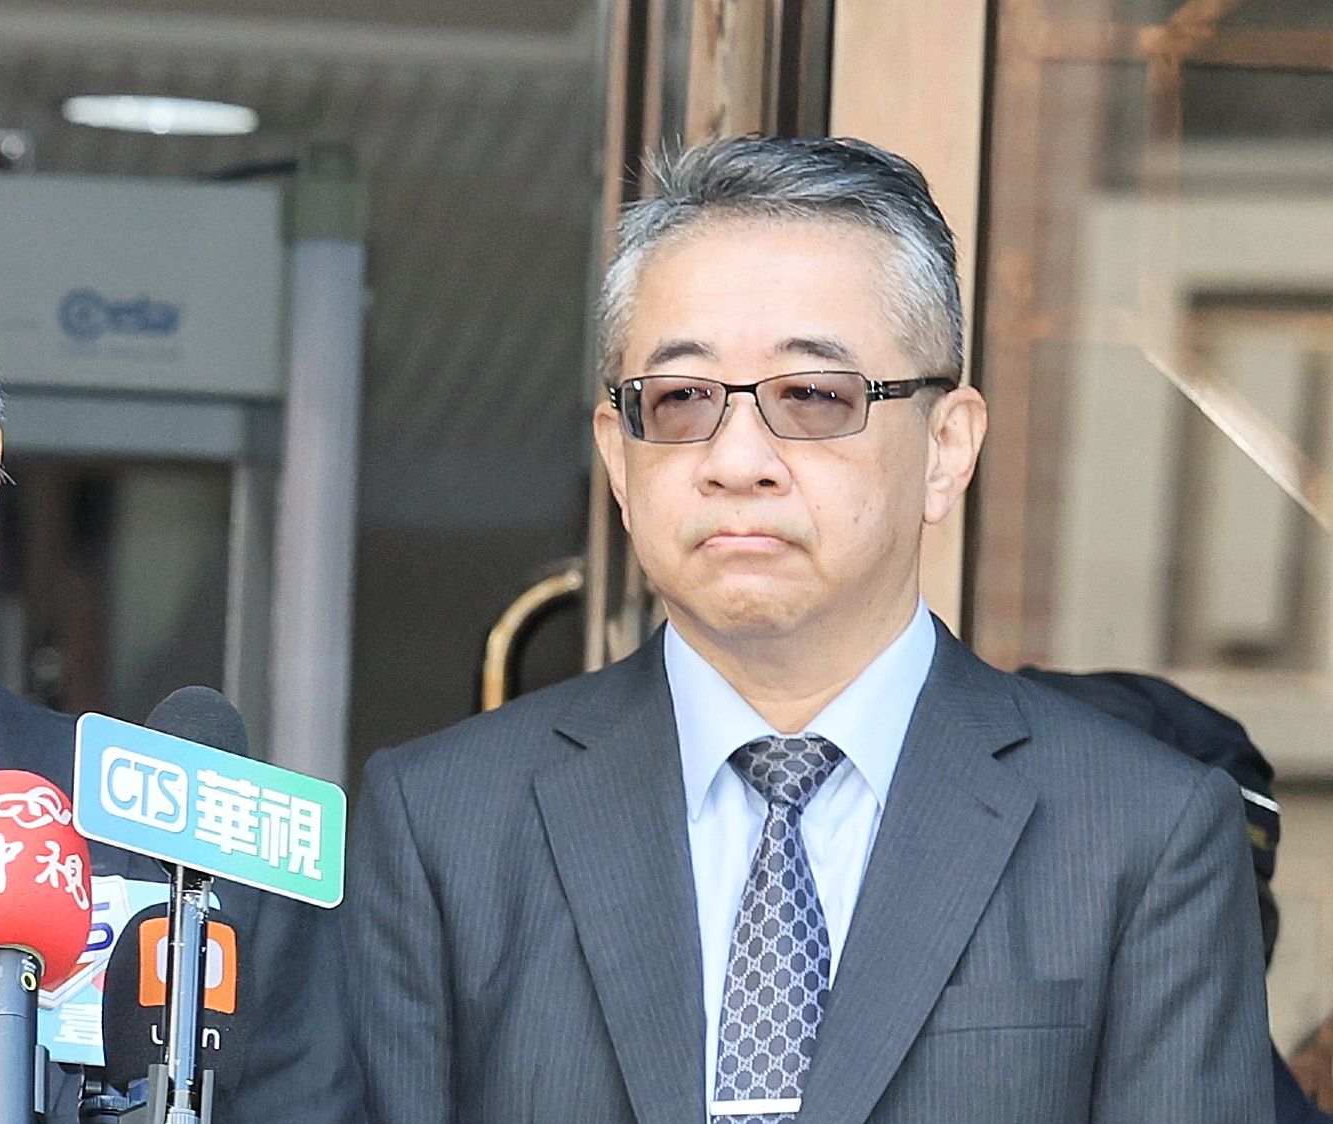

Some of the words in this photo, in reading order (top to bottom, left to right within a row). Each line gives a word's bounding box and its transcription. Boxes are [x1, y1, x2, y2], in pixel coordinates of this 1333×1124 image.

[106, 757, 179, 822] CTS
[194, 768, 323, 881] 華視
[151, 1024, 221, 1050] un
